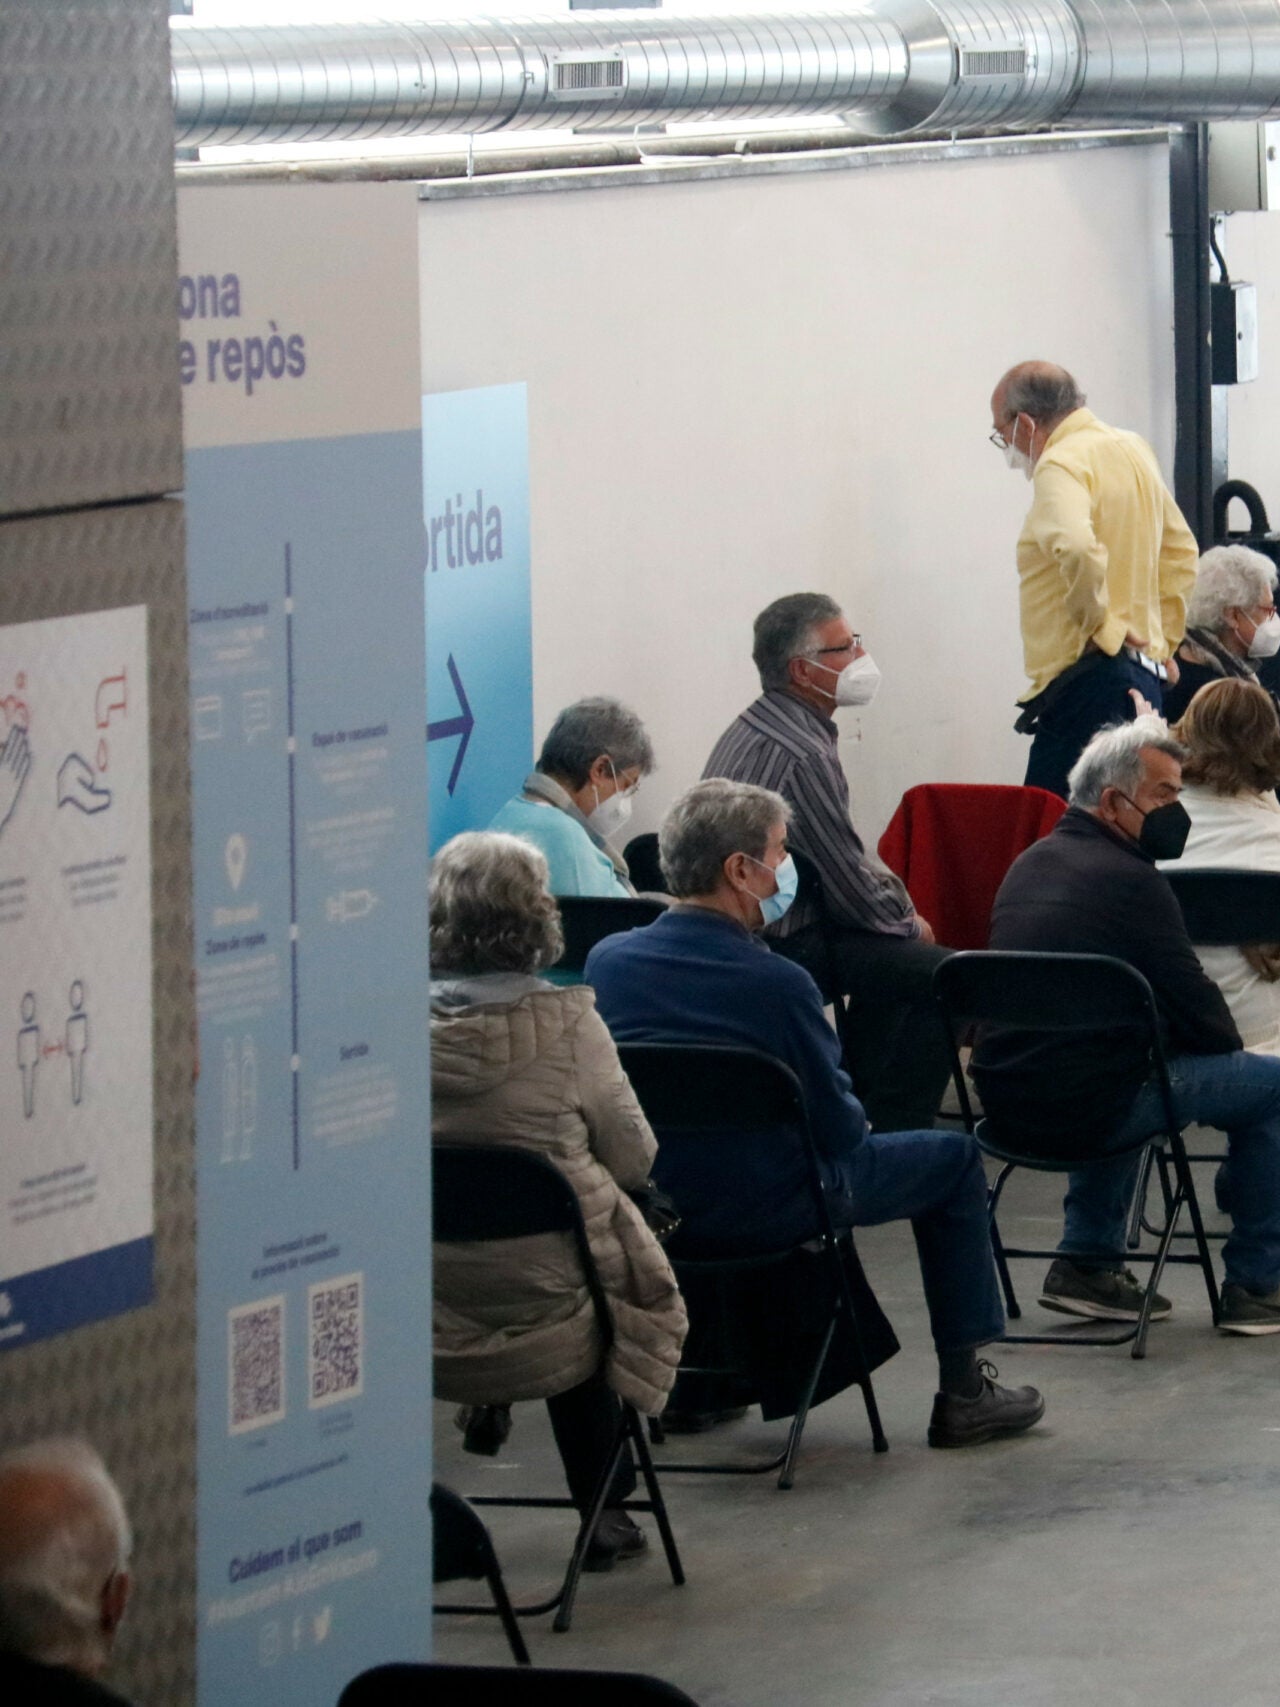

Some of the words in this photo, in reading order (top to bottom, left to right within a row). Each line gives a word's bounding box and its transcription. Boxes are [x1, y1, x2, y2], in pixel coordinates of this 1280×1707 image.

[177, 272, 241, 320] ona
[178, 339, 197, 385] e
[207, 319, 306, 397] repòs
[423, 488, 503, 573] rtida
[228, 1547, 284, 1585] Cuidem
[287, 1535, 301, 1564] el
[303, 1531, 331, 1564] que
[333, 1519, 363, 1548] som
